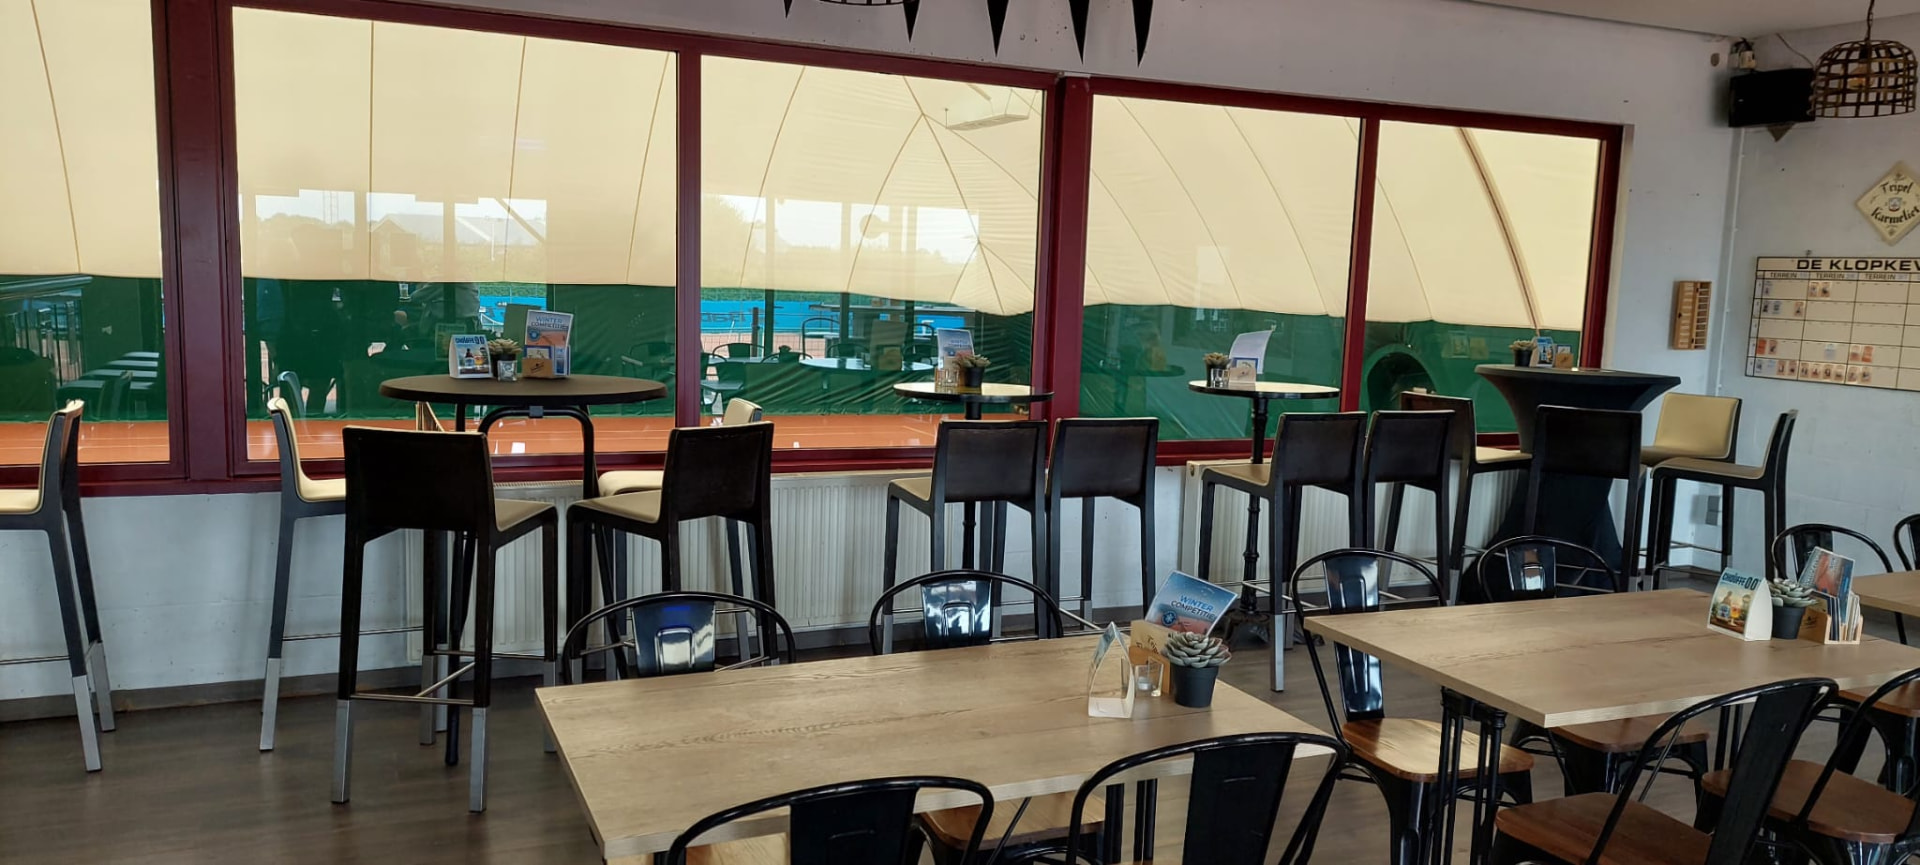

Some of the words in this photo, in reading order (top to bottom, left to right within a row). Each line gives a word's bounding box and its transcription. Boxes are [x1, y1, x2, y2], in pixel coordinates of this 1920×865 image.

[1880, 181, 1914, 196] Tripel
[1796, 259, 1822, 270] DE
[1180, 595, 1214, 611] WINTER
